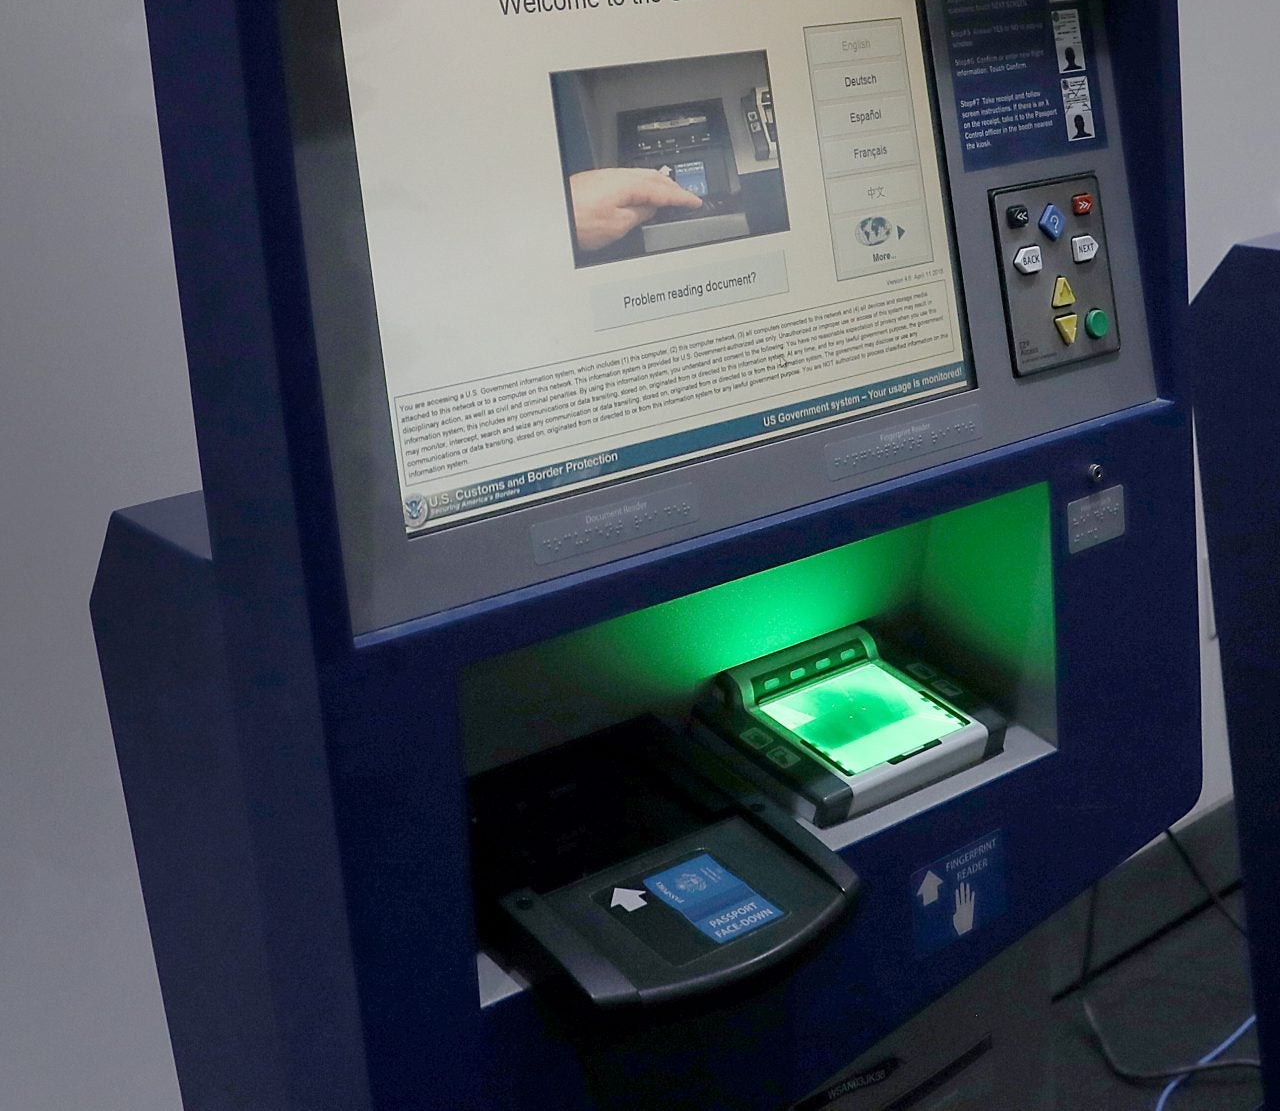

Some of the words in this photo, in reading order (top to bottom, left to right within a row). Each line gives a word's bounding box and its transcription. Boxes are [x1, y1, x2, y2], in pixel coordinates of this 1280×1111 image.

[842, 40, 870, 52] English
[845, 74, 877, 87] Deutsch
[850, 110, 881, 124] Español
[854, 146, 887, 159] Français
[868, 186, 886, 199] 中文
[1079, 243, 1094, 253] NEXT
[1023, 255, 1040, 265] BACK
[624, 291, 665, 308] Problem
[668, 284, 703, 299] reading
[705, 271, 757, 292] document?
[400, 403, 413, 411] You
[427, 393, 458, 407] accessing
[481, 380, 518, 393] Government
[520, 372, 553, 385] information
[578, 364, 594, 372] which
[596, 358, 620, 368] includes
[763, 413, 776, 427] US
[778, 402, 829, 424] Government
[831, 394, 860, 413] system
[868, 389, 886, 399] Your
[889, 381, 911, 395] usage
[913, 378, 920, 388] is
[922, 367, 962, 386] monitored!
[401, 410, 430, 422] attached
[439, 406, 451, 414] this
[452, 400, 475, 411] network
[403, 420, 439, 435] disciplinary
[404, 430, 441, 444] information
[467, 422, 478, 430] this
[479, 416, 505, 427] includes
[507, 414, 518, 422] any
[520, 401, 569, 418] communications
[405, 448, 419, 457] may
[407, 448, 460, 466] communications
[409, 463, 445, 477] information
[429, 492, 452, 507] U.S.
[456, 481, 505, 502] Customs
[507, 475, 525, 488] and
[528, 465, 565, 483] Border
[566, 453, 618, 474] Protection
[586, 510, 622, 524] Document
[624, 502, 647, 513] Reader
[946, 838, 996, 872] FINGERPRINT
[957, 858, 987, 881] READER
[709, 901, 758, 928] PASSPORT
[715, 908, 773, 938] FACE-DOWN
